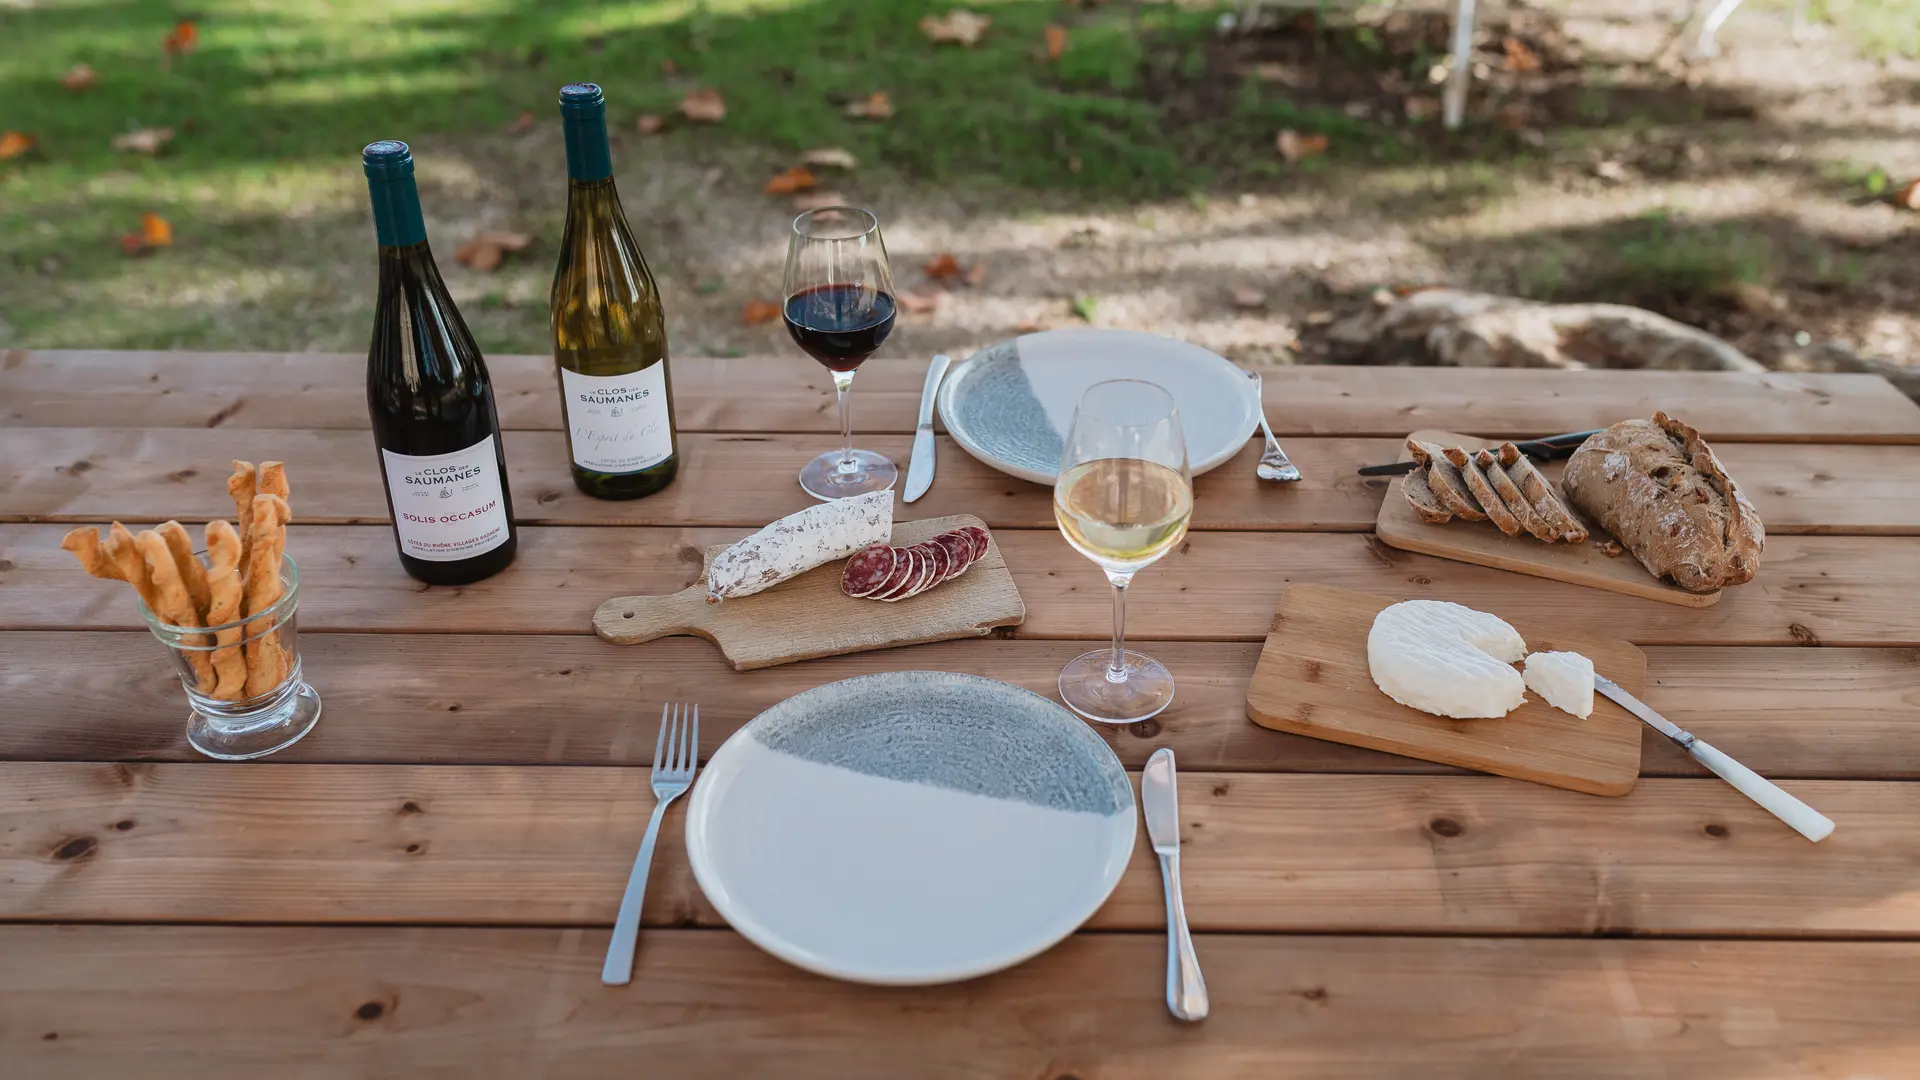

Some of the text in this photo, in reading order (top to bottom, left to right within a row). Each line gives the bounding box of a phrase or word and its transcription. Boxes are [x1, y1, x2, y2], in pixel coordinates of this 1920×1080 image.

[581, 390, 650, 404] SAUMANES
[406, 467, 480, 485] SAUMANES
[424, 466, 456, 475] CLOS
[403, 500, 496, 523] SOLIS OCCASUM
[453, 538, 479, 546] VILLAGES
